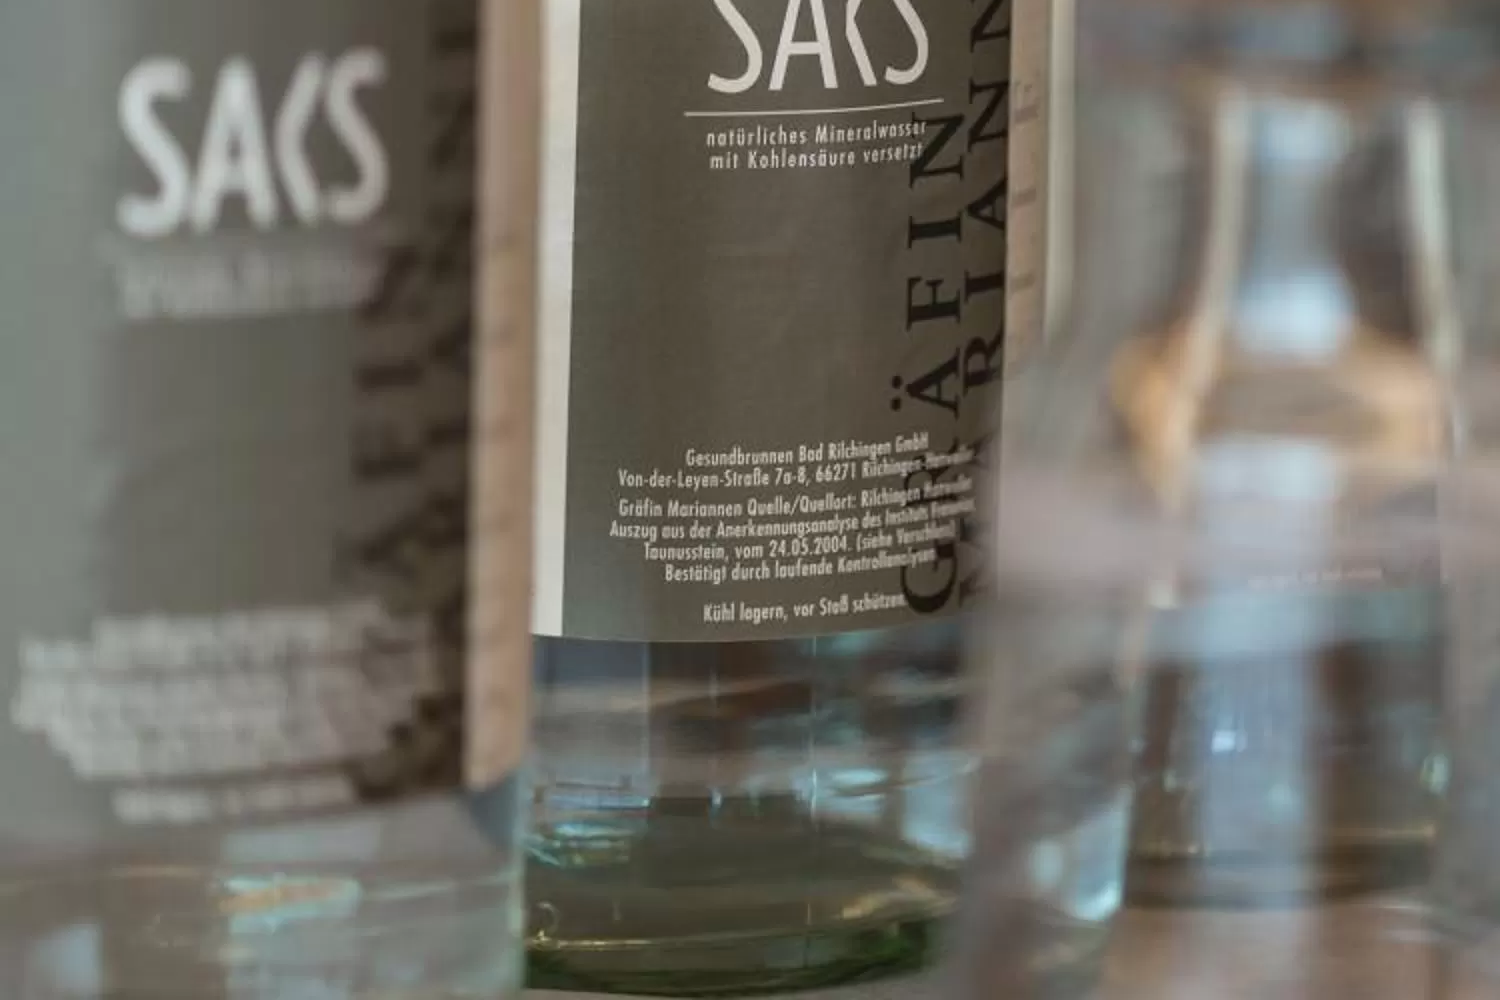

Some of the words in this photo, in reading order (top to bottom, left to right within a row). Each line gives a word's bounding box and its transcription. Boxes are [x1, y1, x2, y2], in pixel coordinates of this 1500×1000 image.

[115, 45, 390, 238] SAKS
[706, 124, 808, 147] natürliches
[815, 119, 927, 144] Mineralwasser
[709, 150, 739, 169] mit
[748, 148, 855, 169] Kohlensäure
[863, 141, 924, 163] versetzt
[890, 110, 966, 615] GRÄFIN
[685, 447, 794, 467] Gesundbrunnen
[799, 442, 824, 462] Bad
[617, 467, 770, 491] Von-der-Leyen-Straße
[815, 461, 857, 483] 66271
[618, 498, 663, 517] Gräfin
[667, 500, 743, 517] Mariannen
[609, 520, 658, 543] Auszug
[661, 525, 685, 539] aus
[689, 520, 712, 539] der
[716, 514, 860, 538] Anerkennungsanalyse
[644, 543, 729, 563] Taunusstein,
[735, 545, 764, 559] vom
[769, 536, 853, 559] 24.05.2004.
[664, 563, 727, 585] Bestätigt
[731, 561, 771, 581] durch
[775, 557, 833, 579] laufende
[703, 602, 735, 622] Kühl
[740, 602, 788, 625] lagern,
[793, 602, 815, 617] vor
